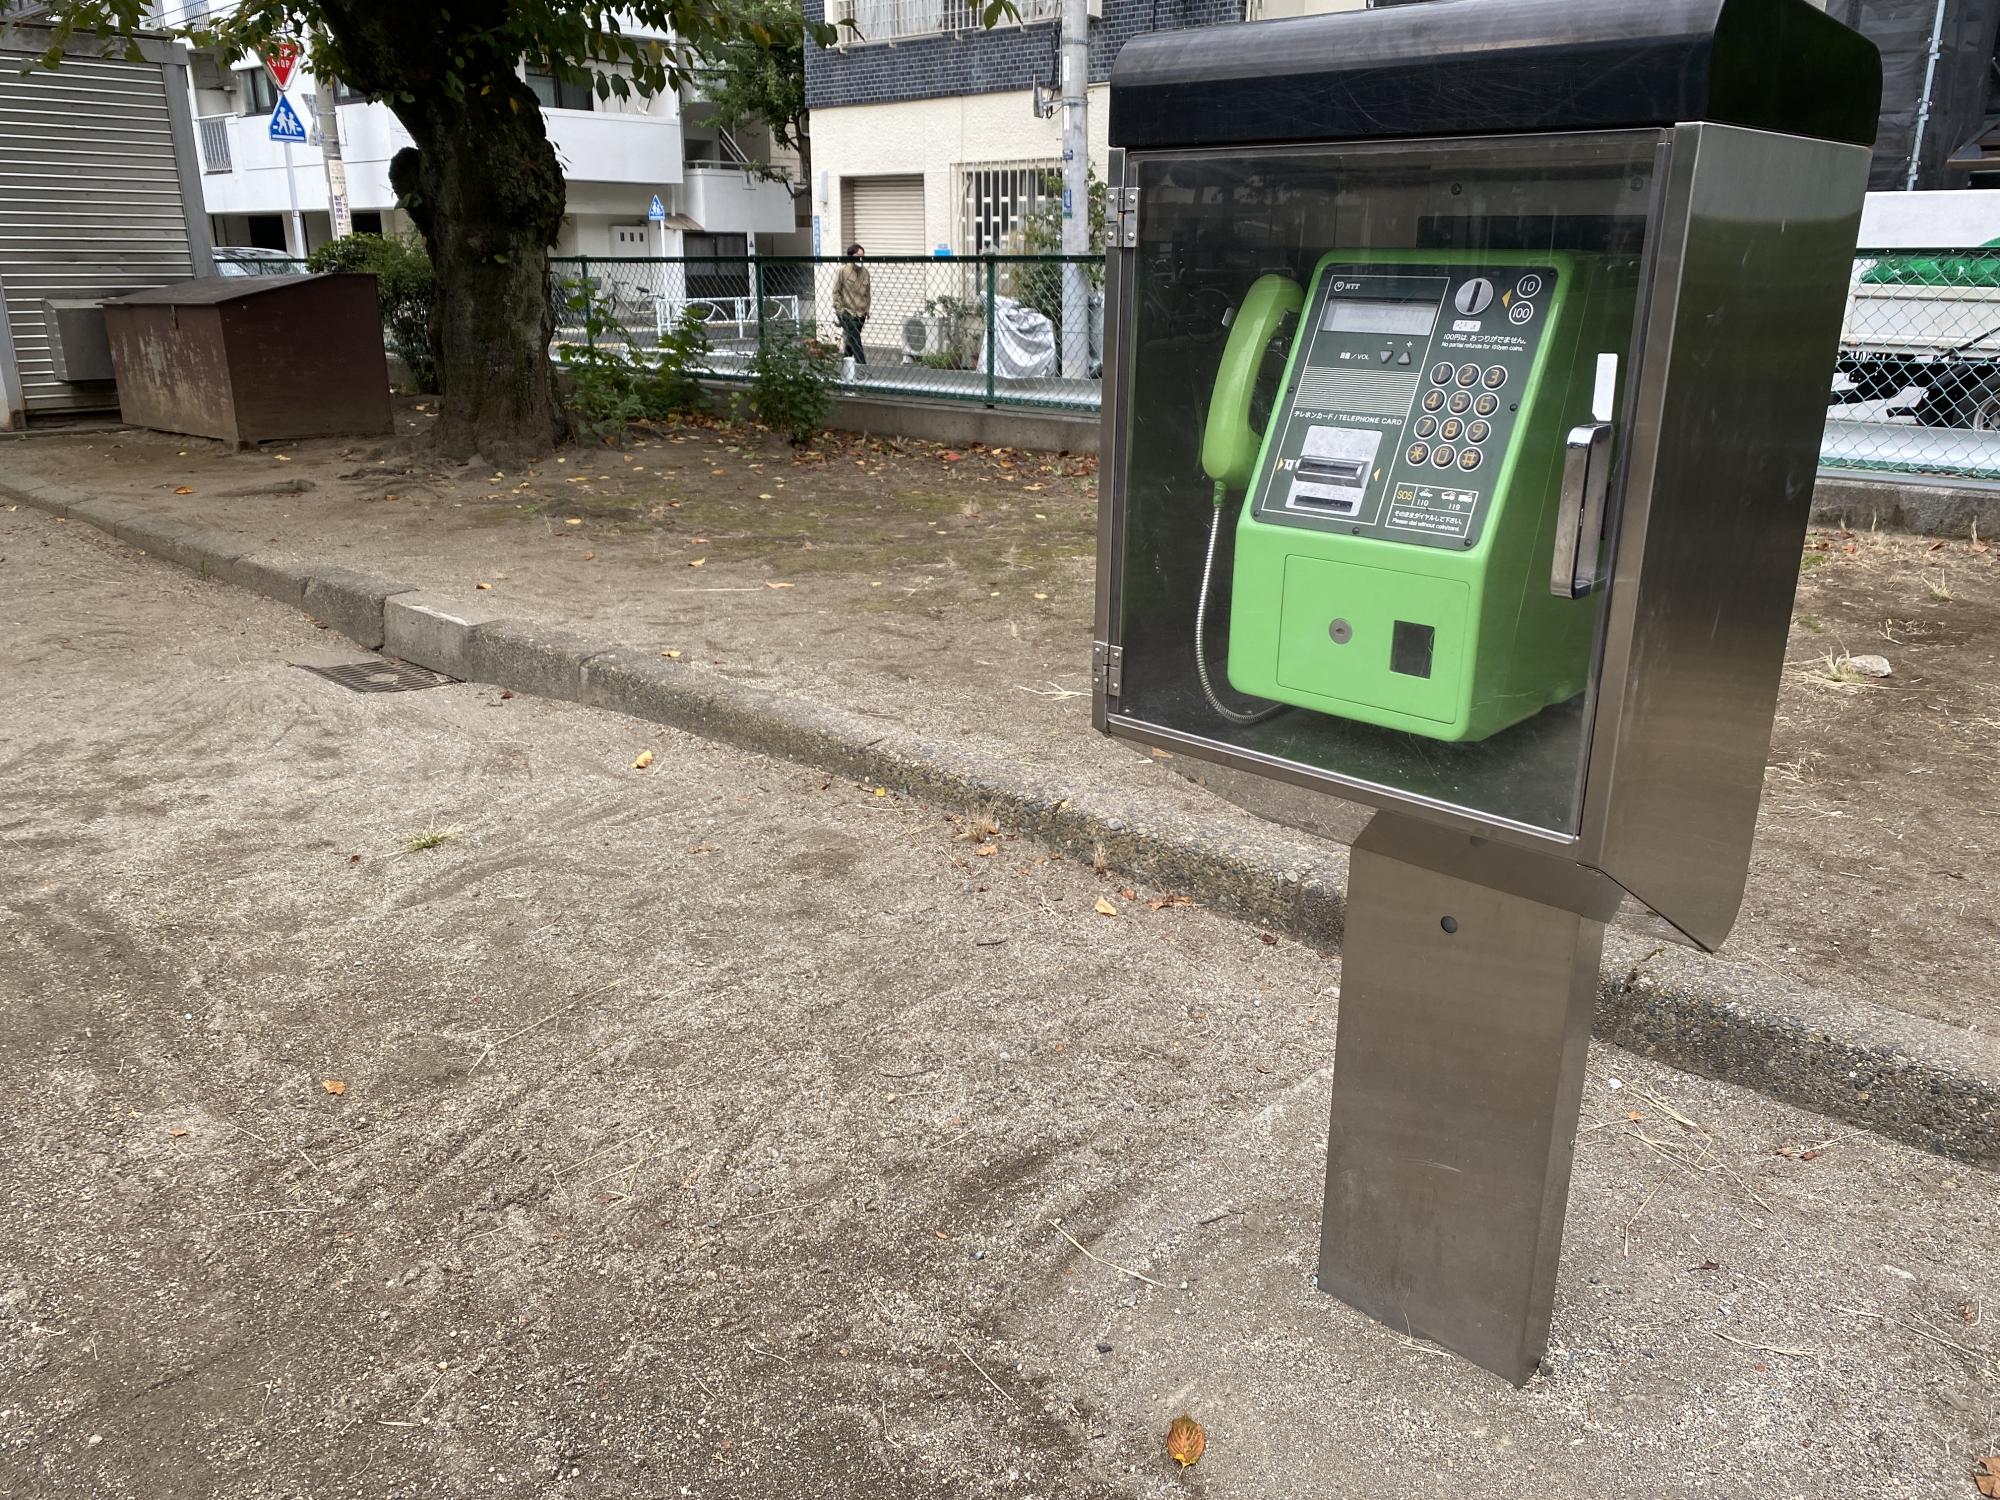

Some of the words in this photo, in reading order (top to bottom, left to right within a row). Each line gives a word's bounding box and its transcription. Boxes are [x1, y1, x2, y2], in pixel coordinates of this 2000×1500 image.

[1522, 280, 1535, 291] 10
[1512, 307, 1529, 318] 100
[1437, 365, 1444, 380] 1
[1461, 367, 1473, 383] 2
[1487, 369, 1500, 385] 3
[1426, 392, 1438, 407] 4
[1453, 394, 1465, 409] 5
[1479, 396, 1491, 412] 6
[1339, 414, 1379, 424] TELEPHONE
[1381, 418, 1403, 426] CARD
[1420, 419, 1431, 434] 7
[1445, 421, 1457, 437] 8
[1472, 423, 1483, 439] 9
[1436, 448, 1449, 464] 0
[1397, 490, 1413, 500] SOS
[1416, 499, 1429, 507] 110
[1448, 503, 1461, 511] 119
